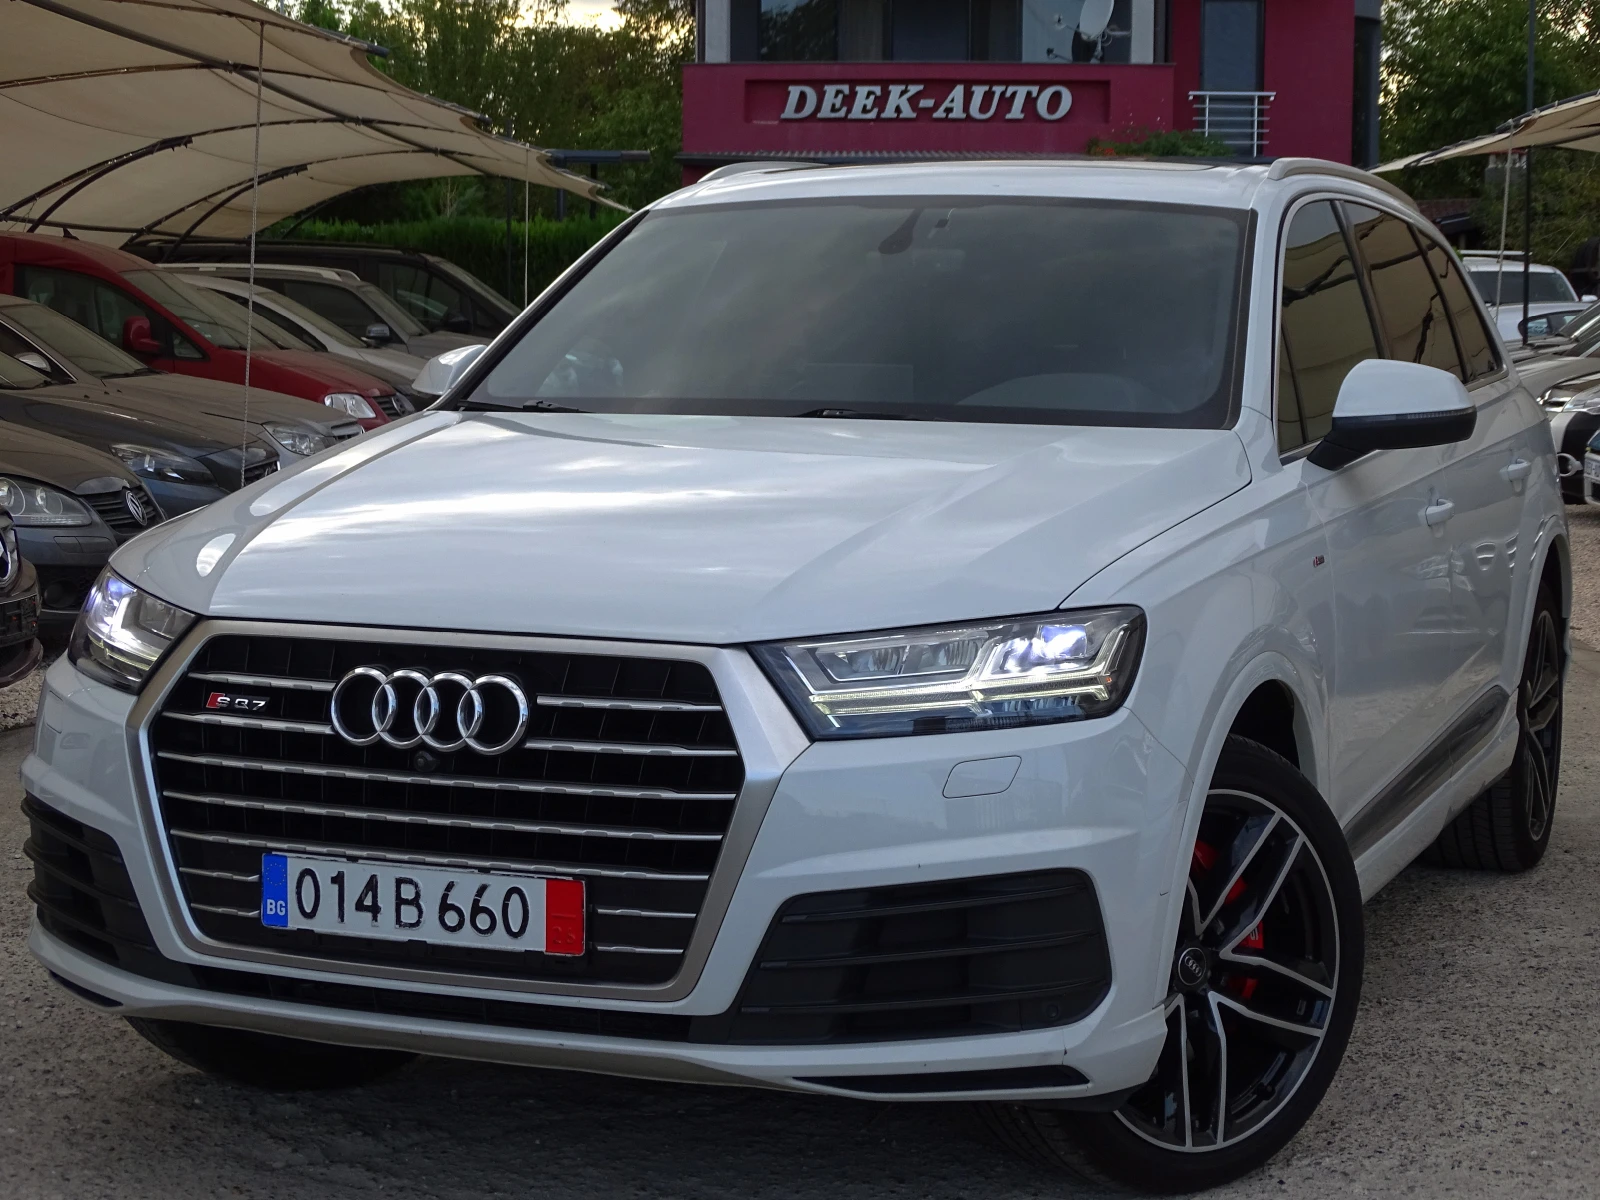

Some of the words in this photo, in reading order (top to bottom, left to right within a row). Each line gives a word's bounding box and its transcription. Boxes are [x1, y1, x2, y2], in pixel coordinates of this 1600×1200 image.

[780, 84, 1073, 120] DEEK-AUTO
[216, 696, 267, 710] SQ7
[266, 898, 286, 916] BG
